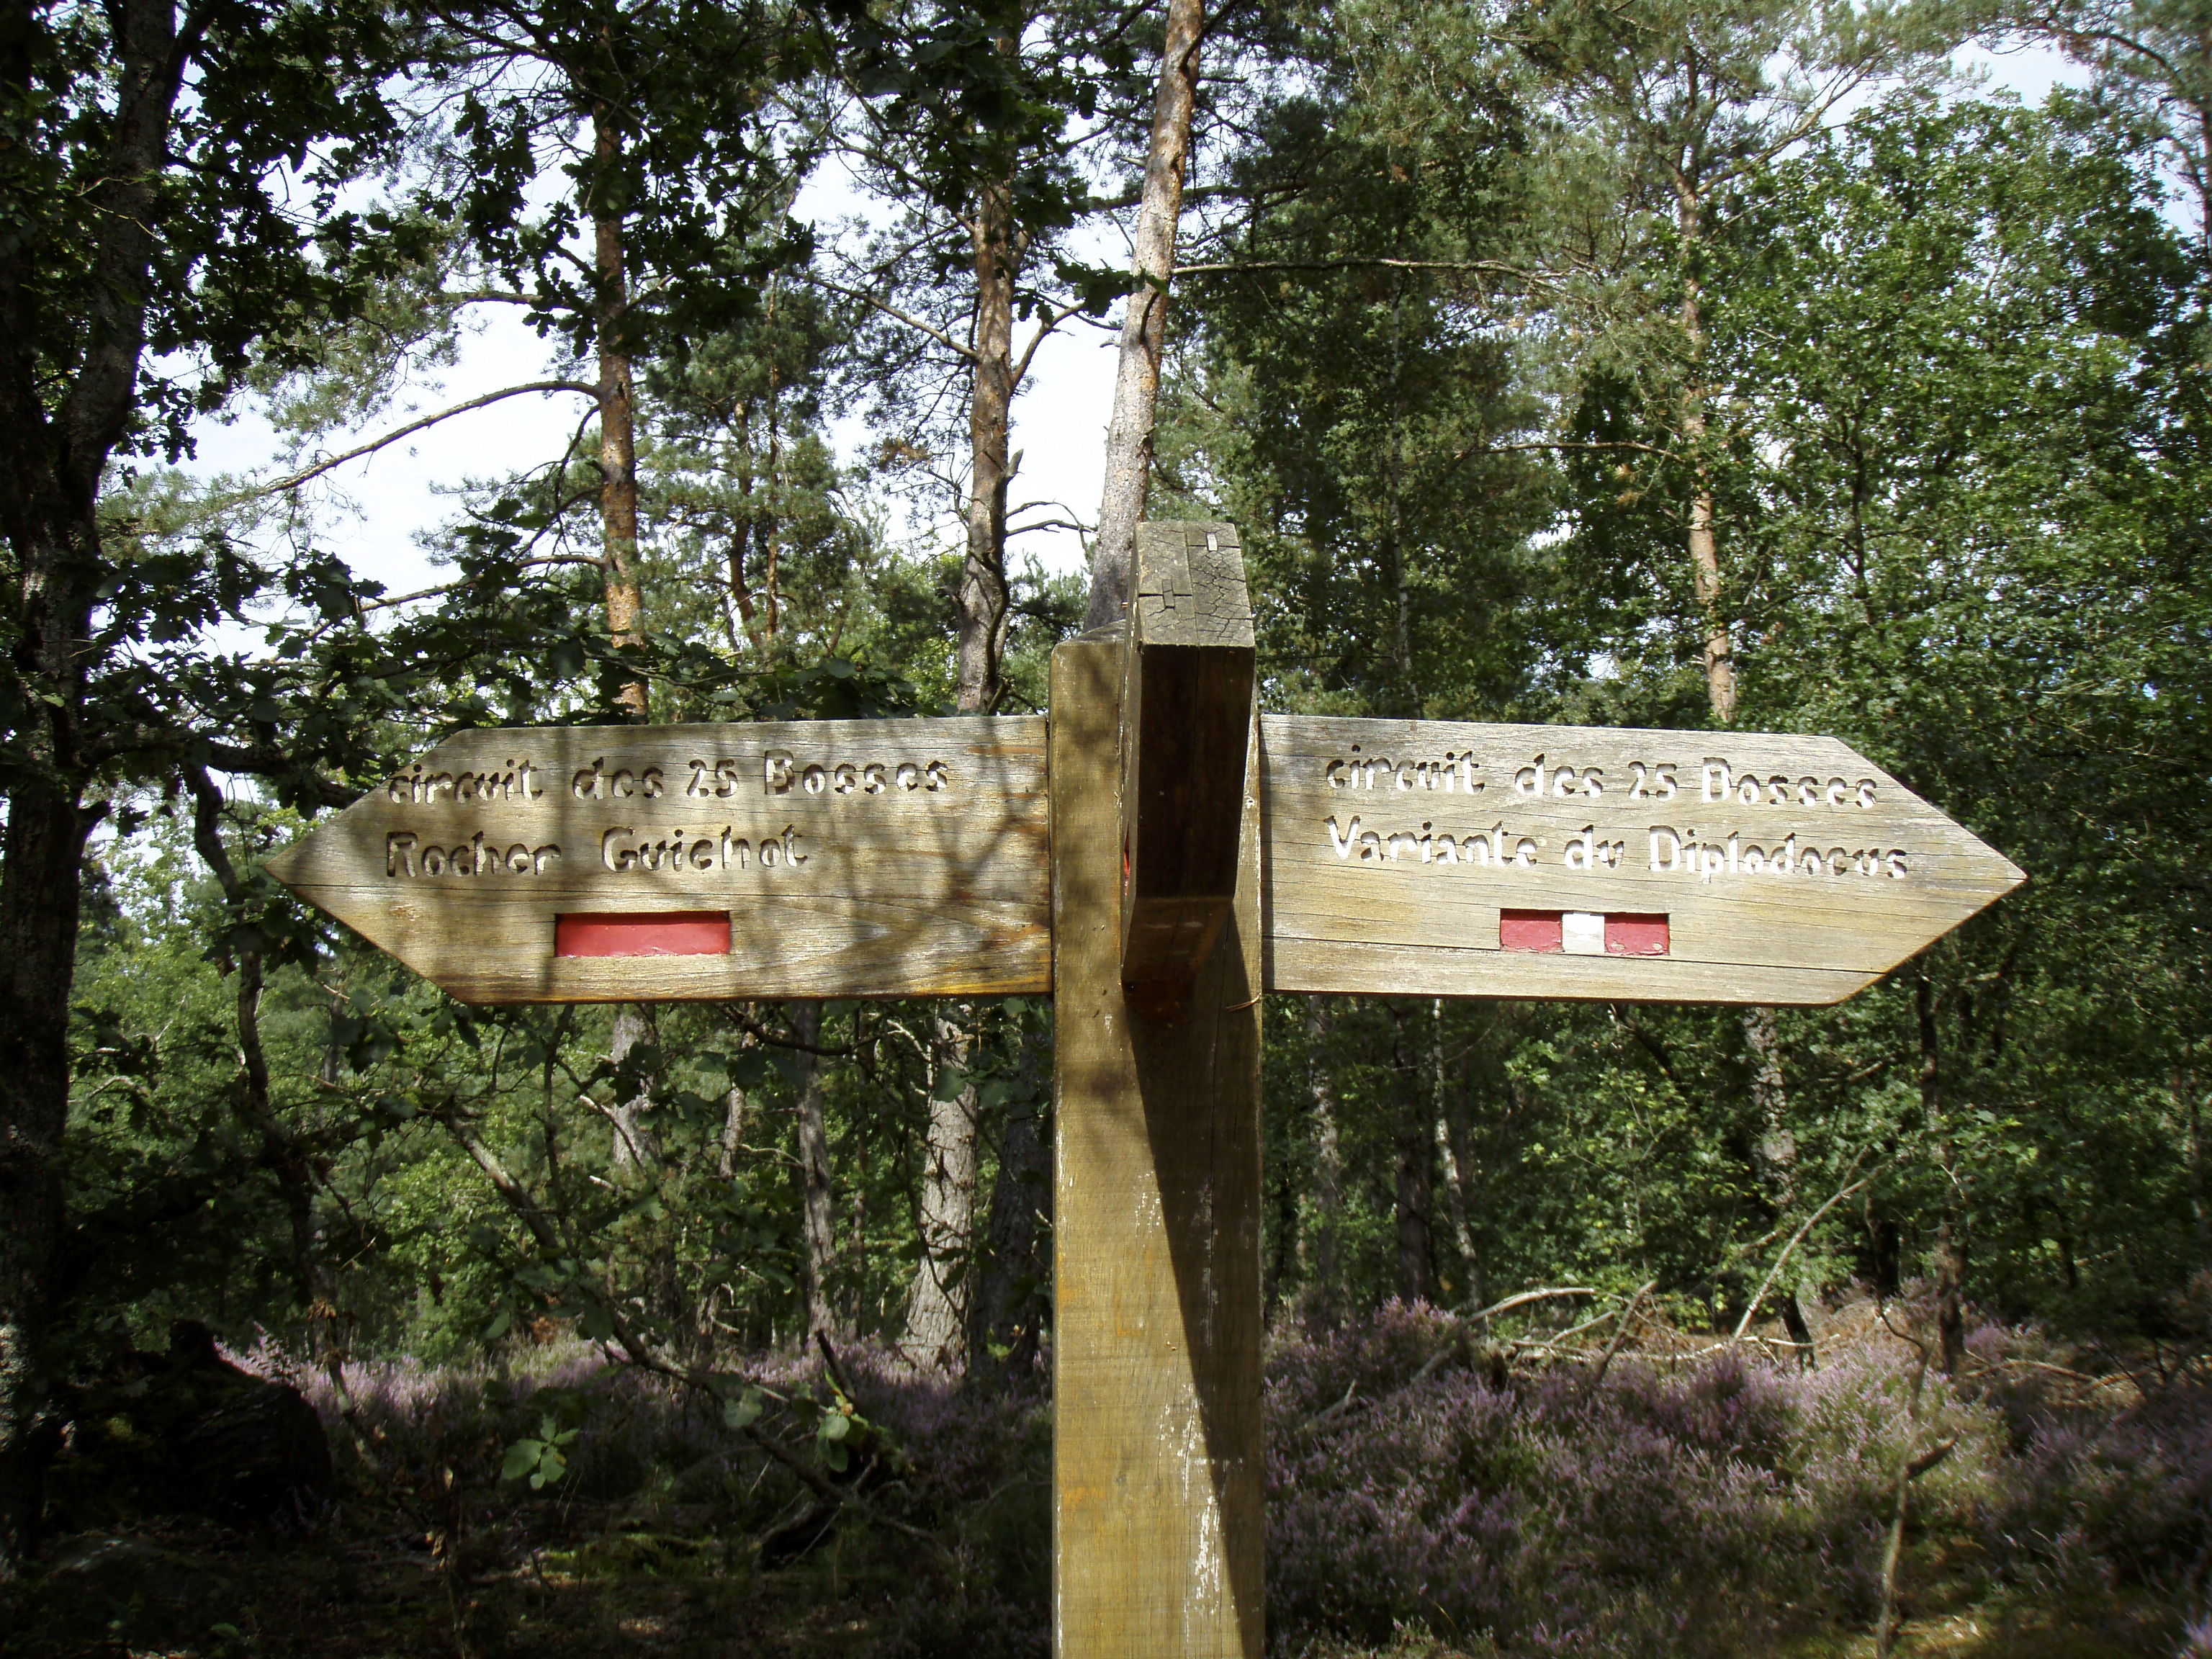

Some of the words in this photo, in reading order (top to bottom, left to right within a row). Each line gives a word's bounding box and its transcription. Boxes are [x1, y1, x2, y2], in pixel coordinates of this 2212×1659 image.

[387, 758, 543, 804] circuit
[572, 756, 663, 799] des
[686, 759, 739, 797] 25
[764, 749, 948, 795] Bosses
[1326, 745, 1485, 794] circuit
[1515, 753, 1604, 798] des
[1628, 760, 1677, 801] 25
[1701, 757, 1877, 809] Bosses
[386, 830, 562, 877] Rocher
[601, 824, 808, 873] Guichot
[1323, 815, 1537, 867] Variante
[1564, 824, 1624, 869] du
[1649, 824, 1908, 884] Diplodocus
